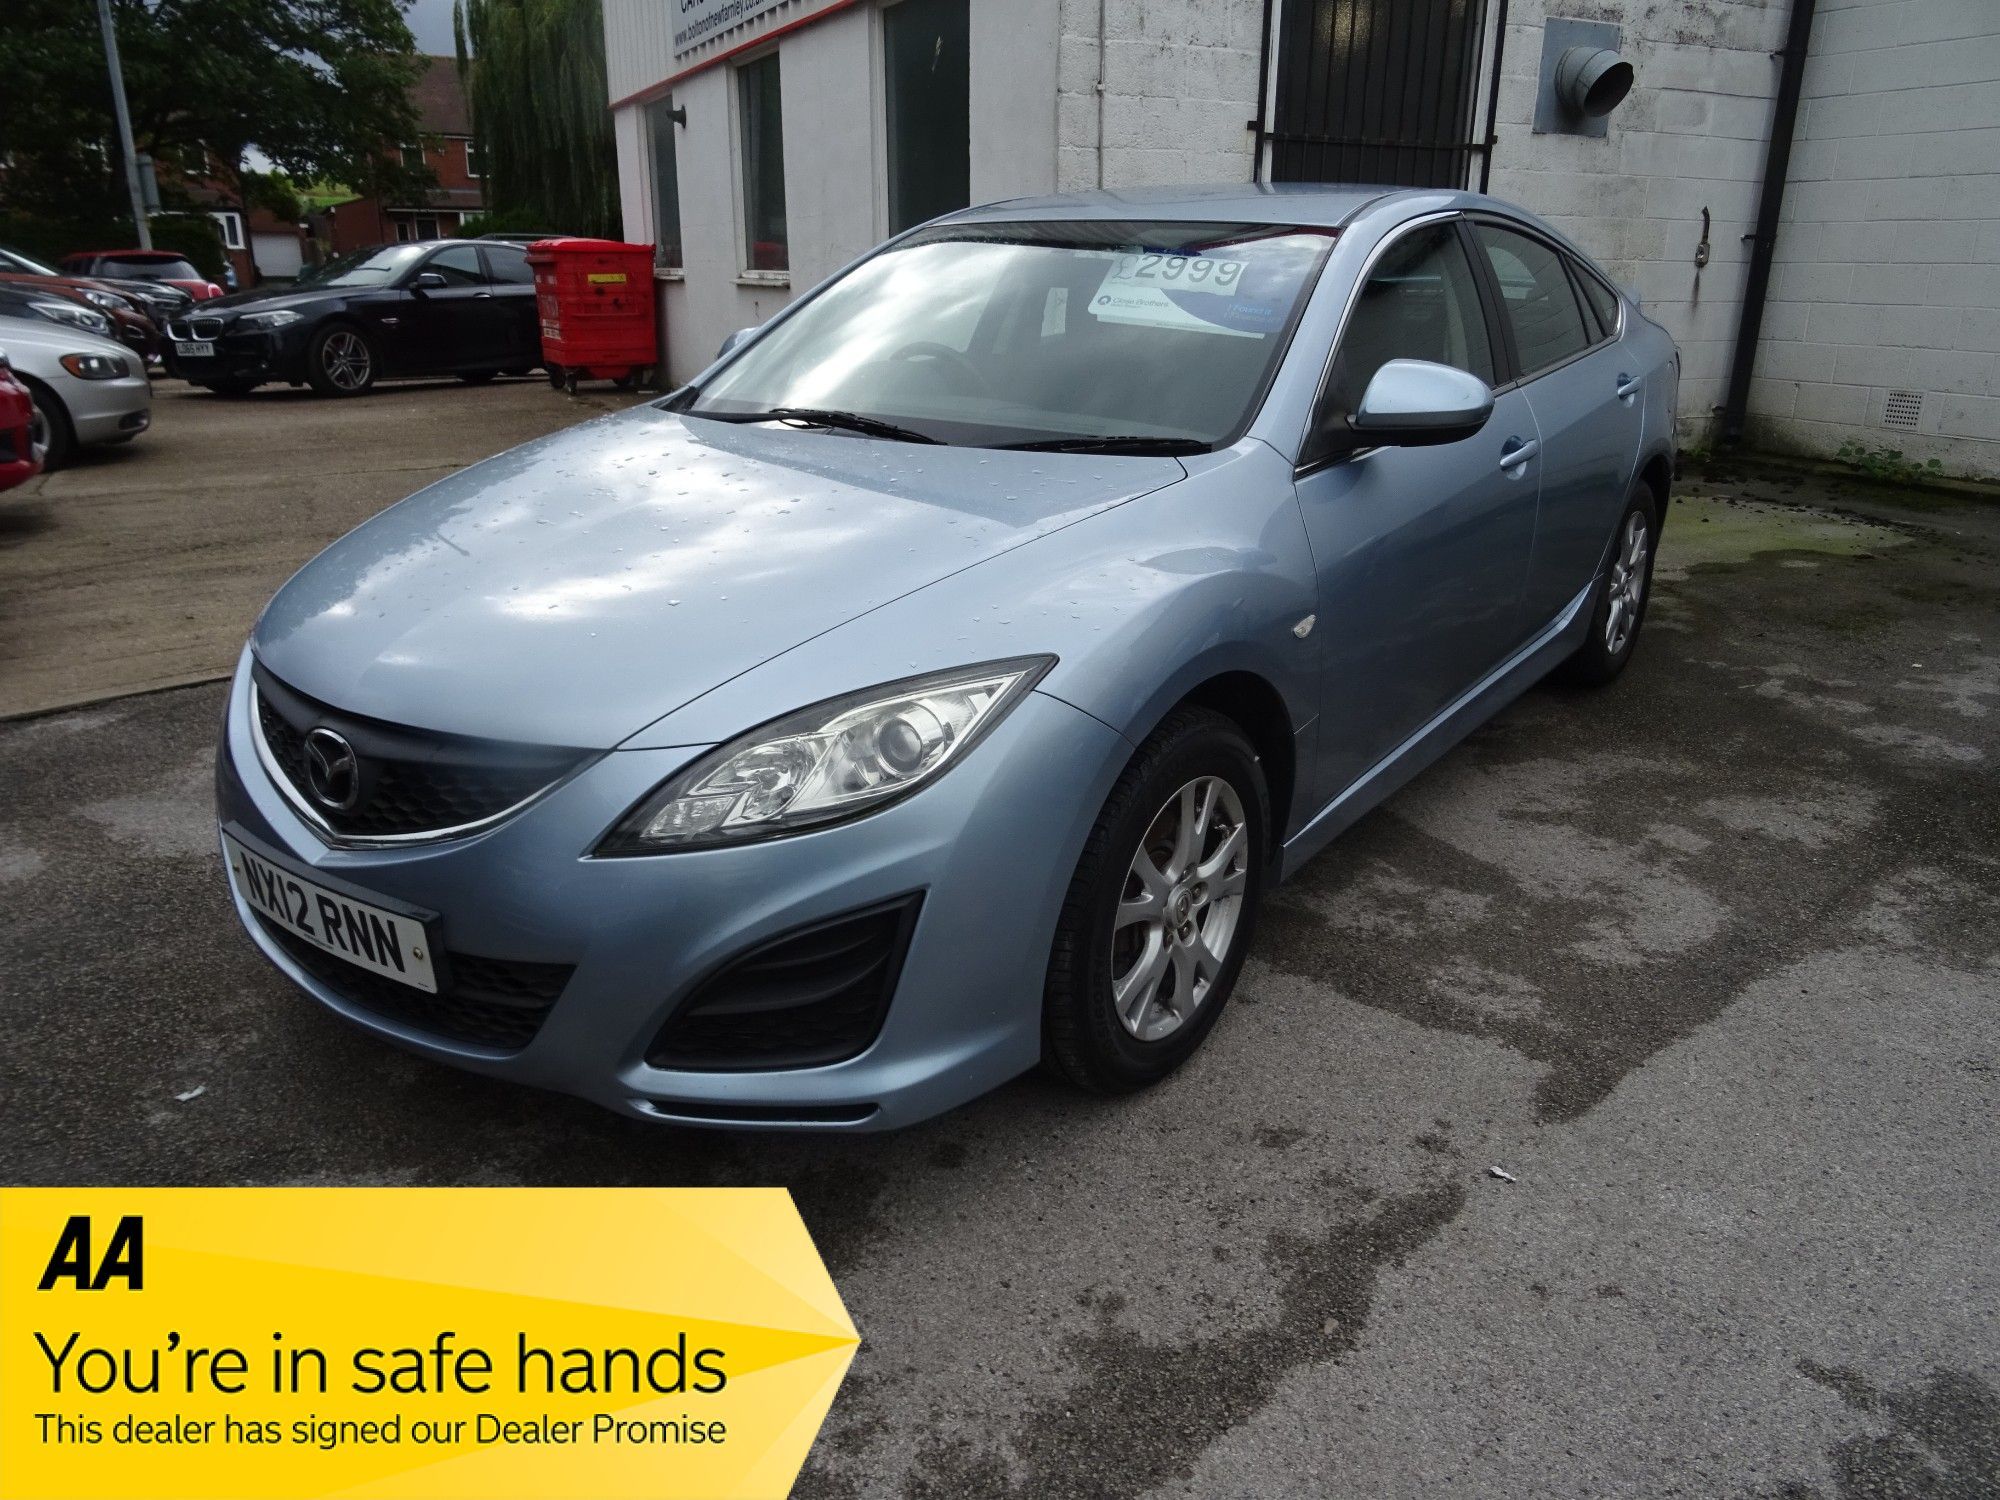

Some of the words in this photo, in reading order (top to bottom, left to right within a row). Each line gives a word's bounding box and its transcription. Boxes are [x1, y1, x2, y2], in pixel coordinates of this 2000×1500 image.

[1111, 254, 1242, 287] £2999
[240, 851, 316, 937] NX12
[315, 892, 406, 974] RNN
